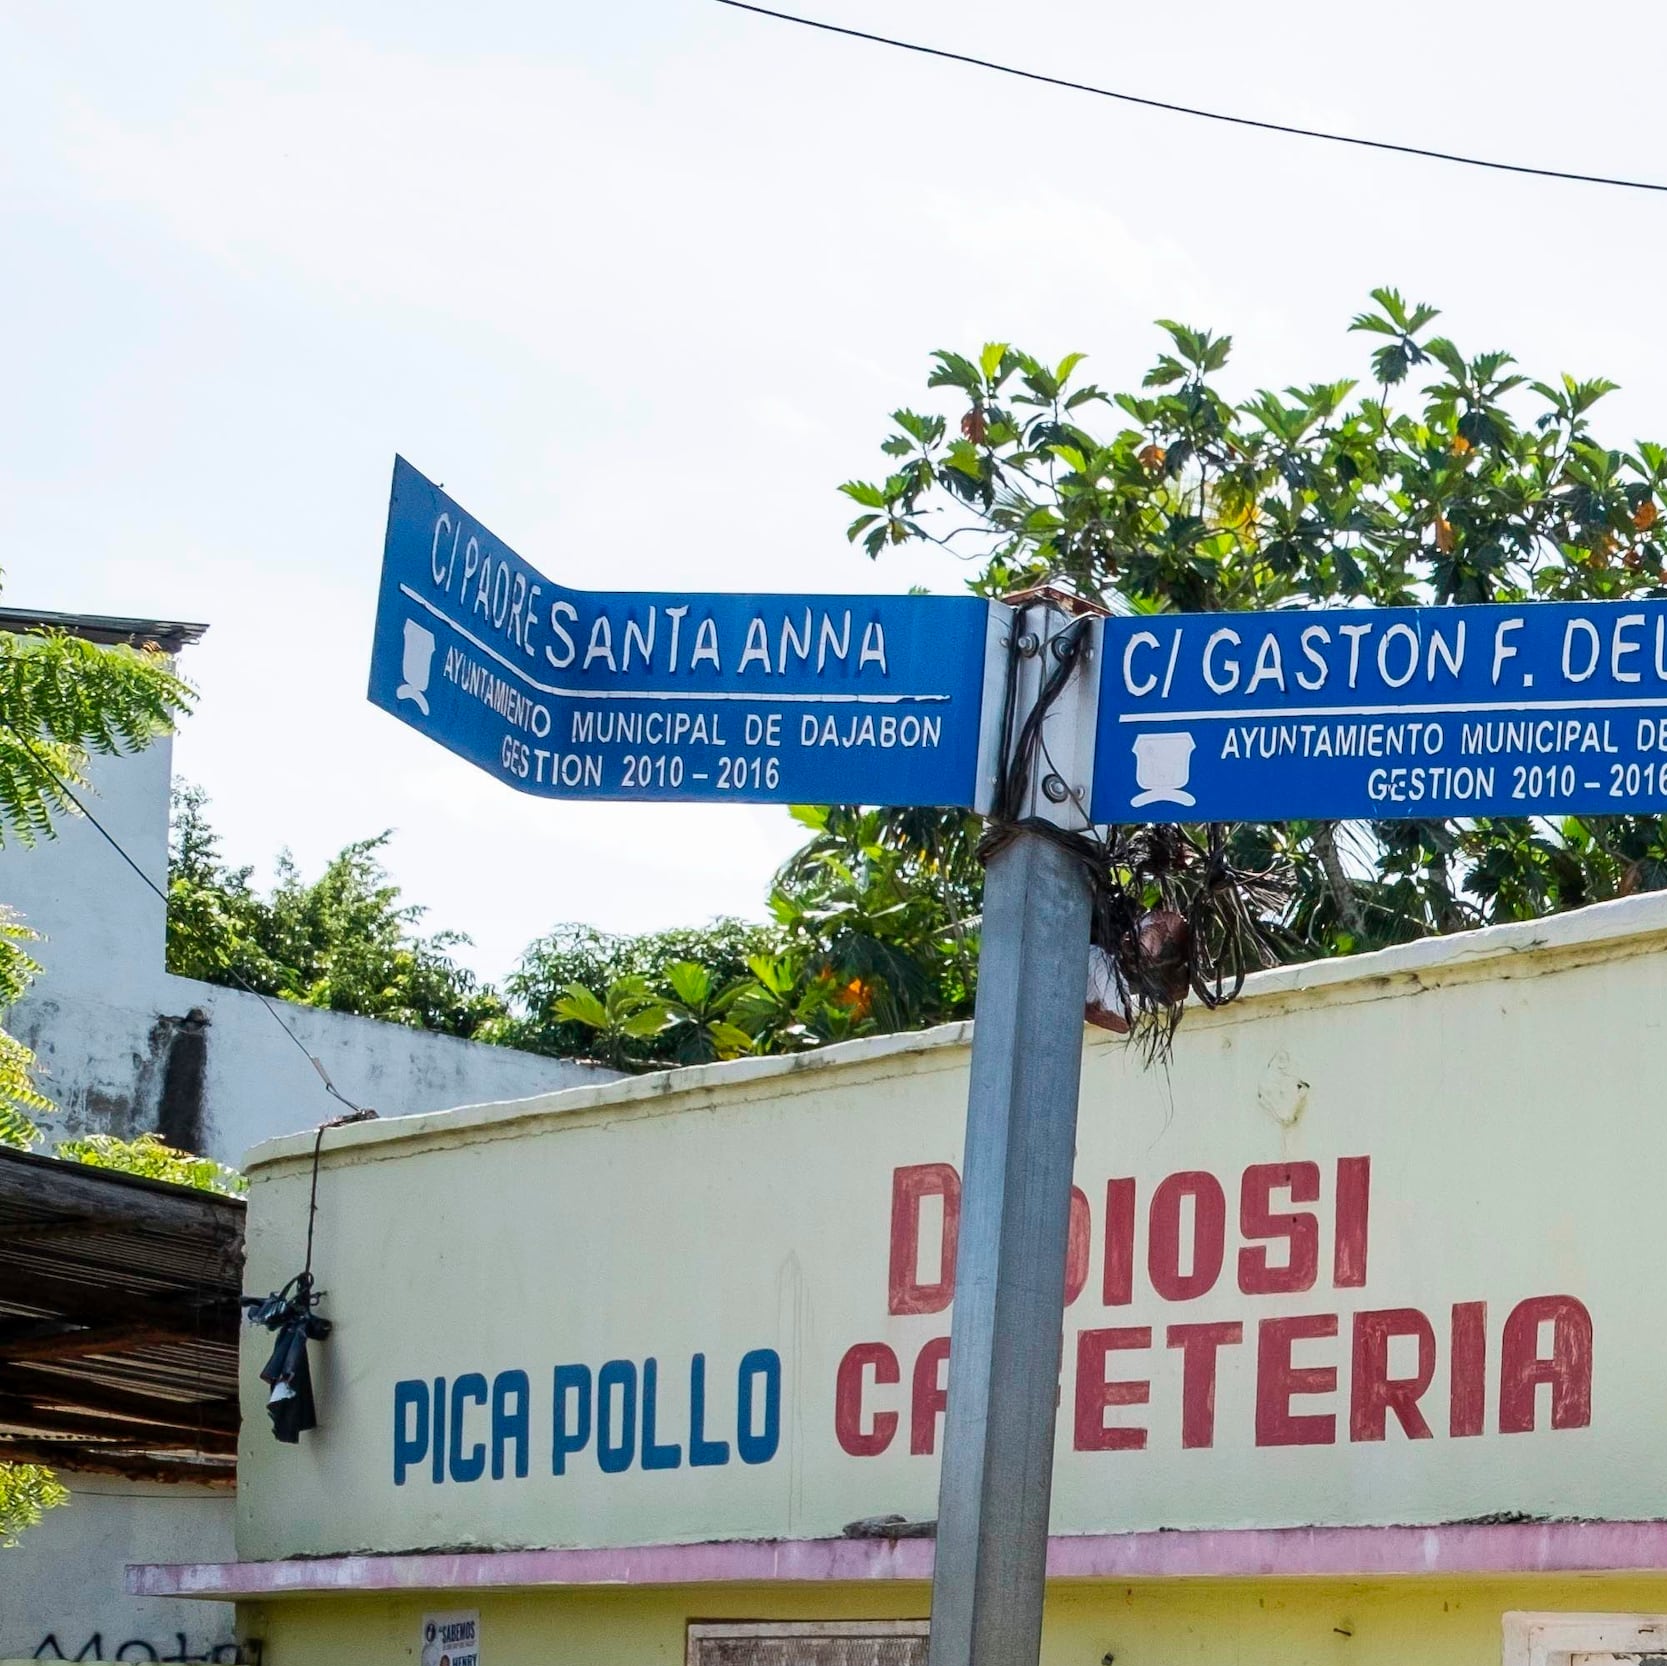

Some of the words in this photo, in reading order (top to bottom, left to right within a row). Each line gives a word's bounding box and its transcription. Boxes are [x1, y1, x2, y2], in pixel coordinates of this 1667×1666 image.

[545, 600, 721, 673] SANTA
[737, 606, 887, 675] ANNA
[1122, 628, 1182, 700] C/
[1201, 620, 1464, 694] GASTON
[1492, 618, 1535, 688] F.
[442, 645, 552, 738] AYUNTAMIENTO
[571, 712, 726, 746] MUNICIPAL
[745, 713, 781, 747] DE
[800, 714, 941, 748] DAJABON
[501, 734, 602, 787] GESTION
[622, 756, 684, 788] 2010
[716, 757, 780, 790] 2016
[1221, 722, 1443, 760] AYUNTAMIENTO
[1462, 719, 1620, 755] MUNICIPAL
[1367, 766, 1494, 802] GESTION
[1511, 765, 1576, 799] 2010
[835, 1295, 1592, 1456] CAETERIA
[393, 1368, 529, 1487] PICA
[552, 1349, 781, 1482] POLLO
